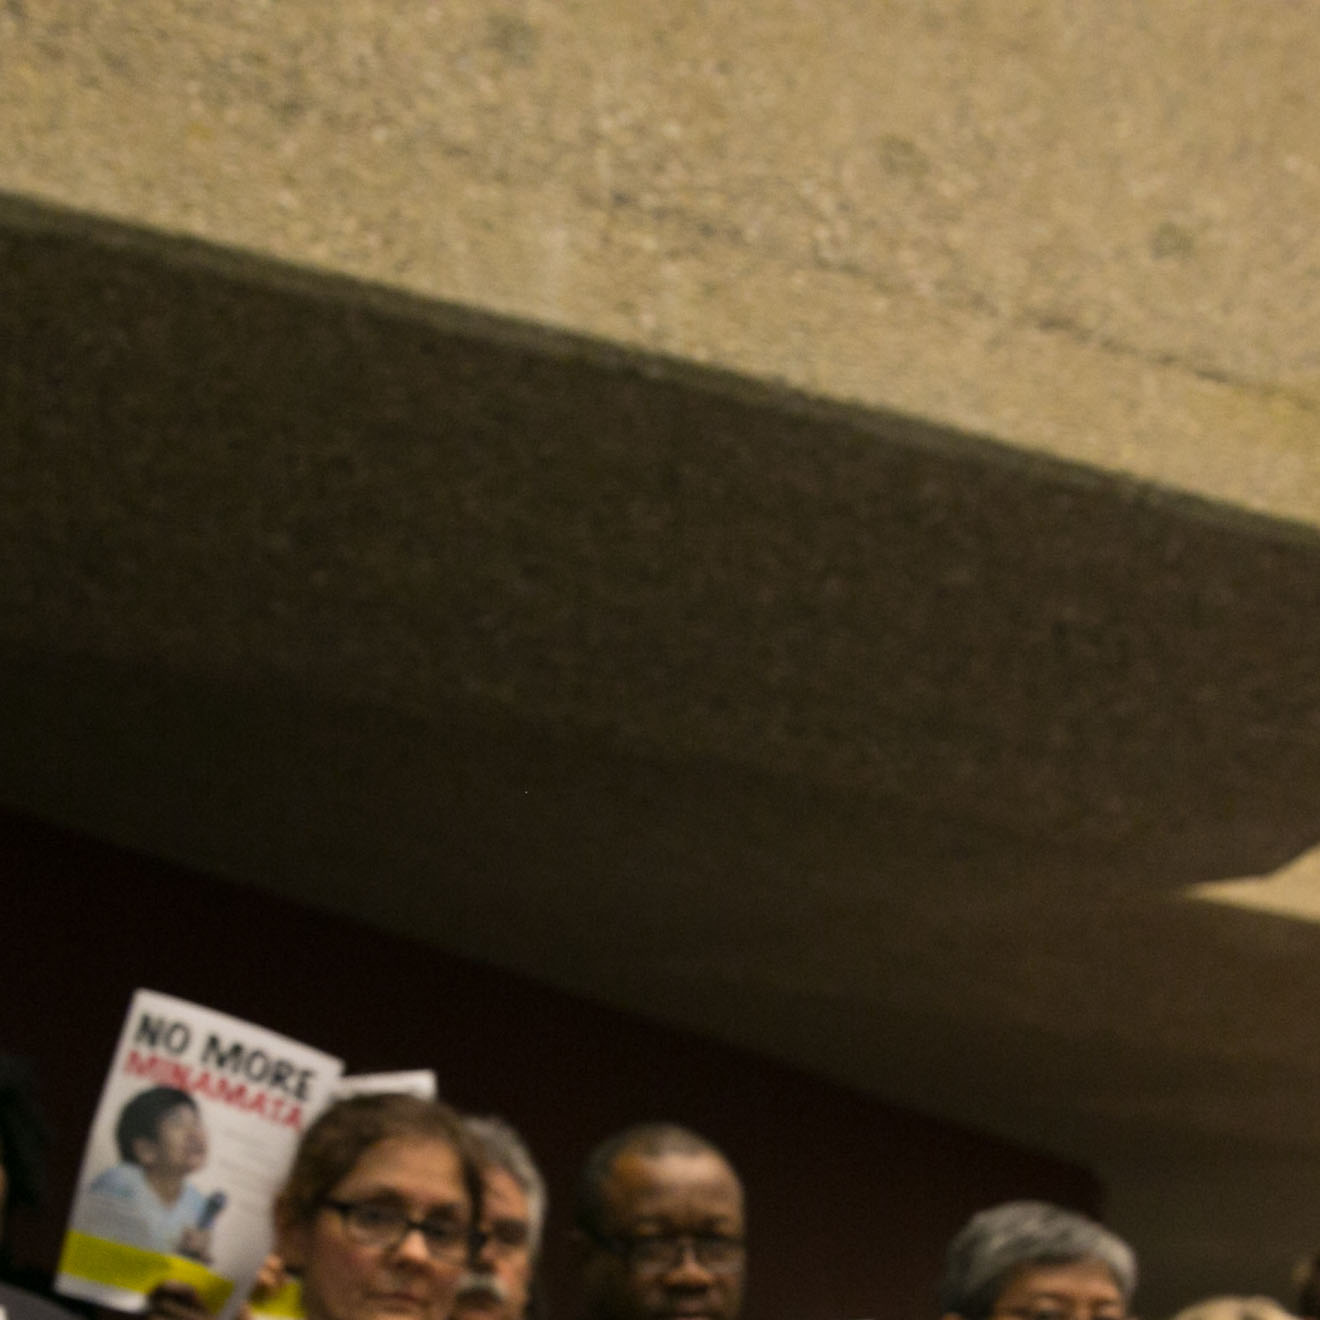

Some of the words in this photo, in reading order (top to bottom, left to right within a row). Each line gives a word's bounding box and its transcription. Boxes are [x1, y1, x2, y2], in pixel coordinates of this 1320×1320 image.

[125, 1049, 304, 1131] MINAMATA
[136, 1013, 191, 1054] NO
[201, 1034, 316, 1100] MORE
